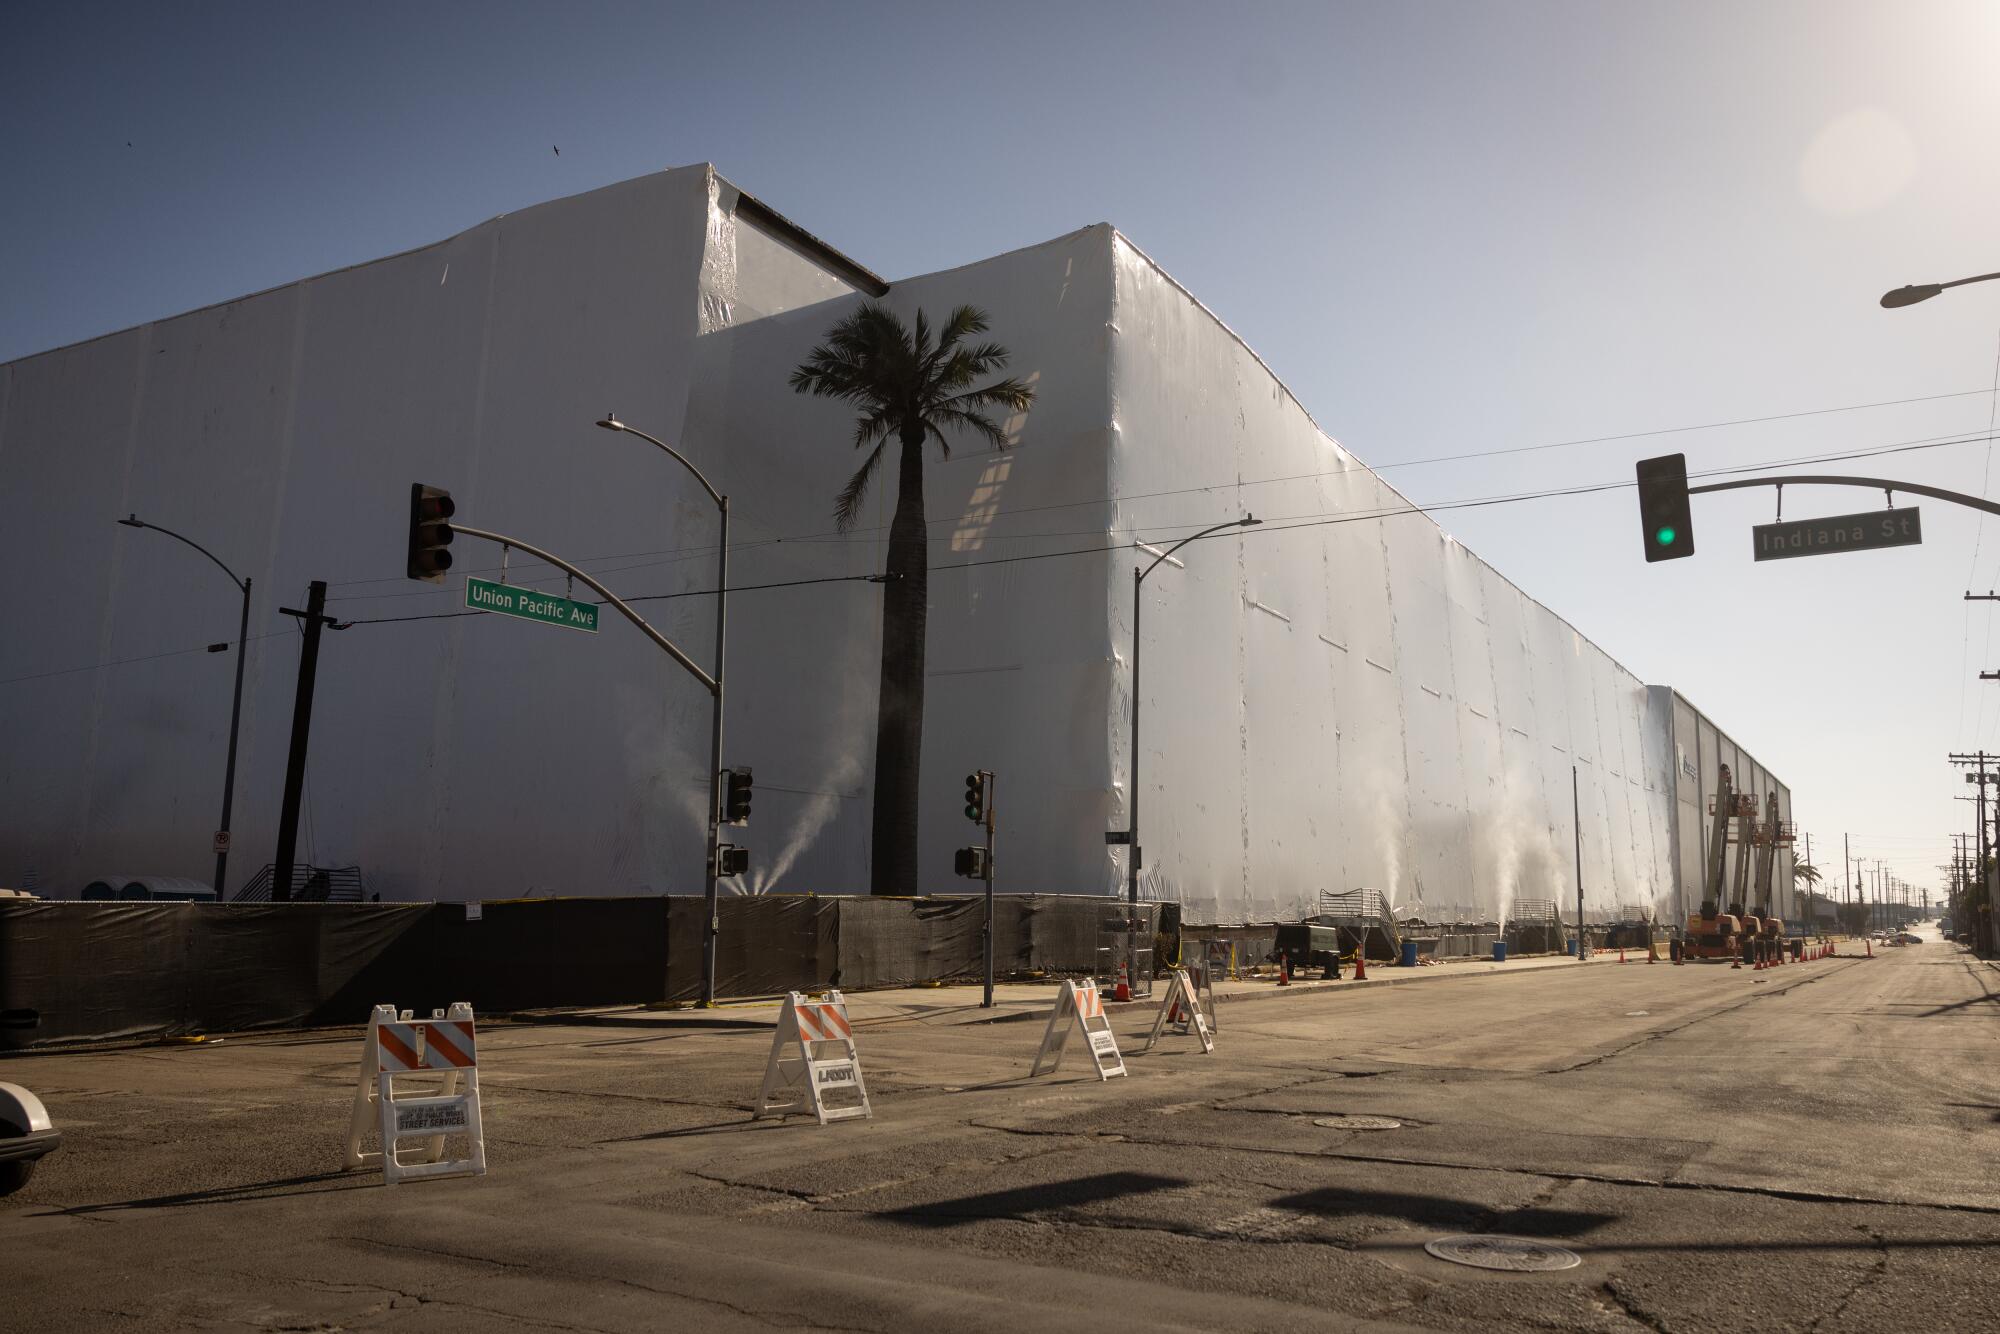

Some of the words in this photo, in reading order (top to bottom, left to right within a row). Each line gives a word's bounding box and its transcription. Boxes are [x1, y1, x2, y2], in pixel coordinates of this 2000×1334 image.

[1763, 527, 1864, 550] Indiana
[1881, 519, 1910, 537] St
[473, 586, 512, 607] Union
[519, 596, 564, 618] Pacific
[571, 608, 594, 624] Ave
[819, 1068, 852, 1082] LADOT
[400, 1119, 428, 1128] STREET
[430, 1117, 465, 1127] SERVICES
